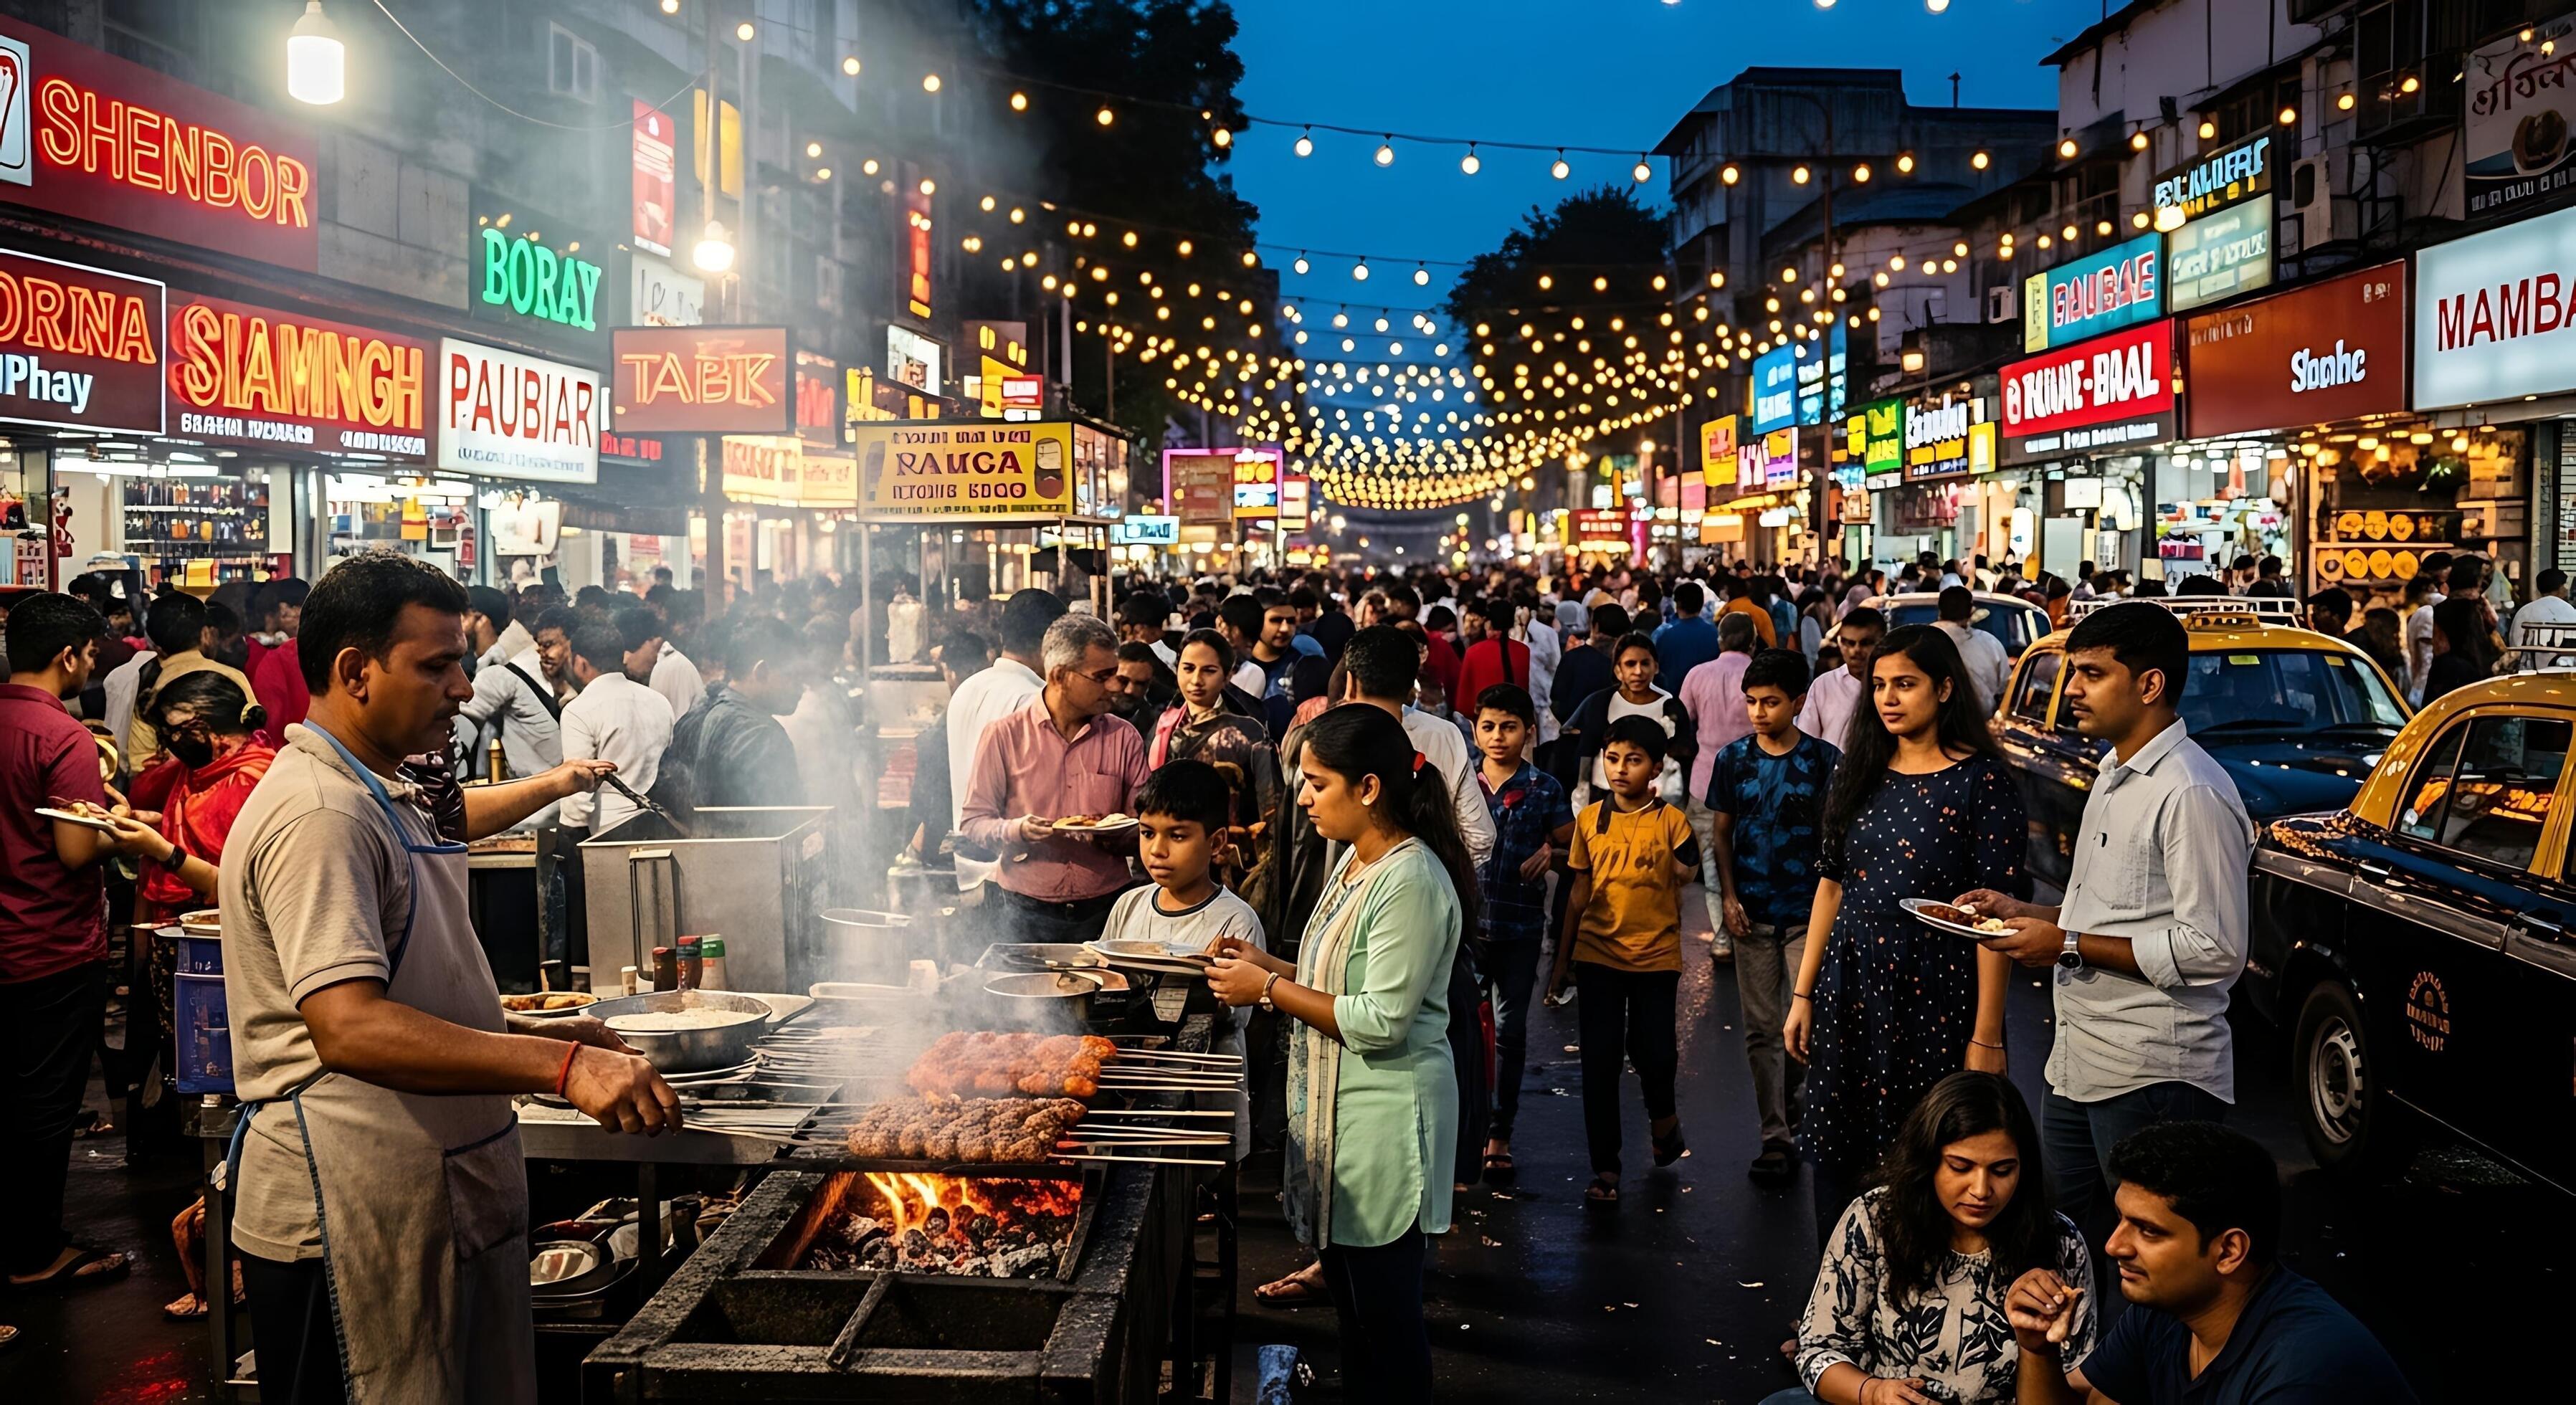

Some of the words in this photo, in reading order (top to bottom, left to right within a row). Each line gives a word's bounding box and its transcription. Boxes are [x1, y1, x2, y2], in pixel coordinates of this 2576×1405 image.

[41, 79, 309, 228] SHENBOR
[483, 228, 602, 332] BORAY
[451, 353, 591, 448] PAUBIAR
